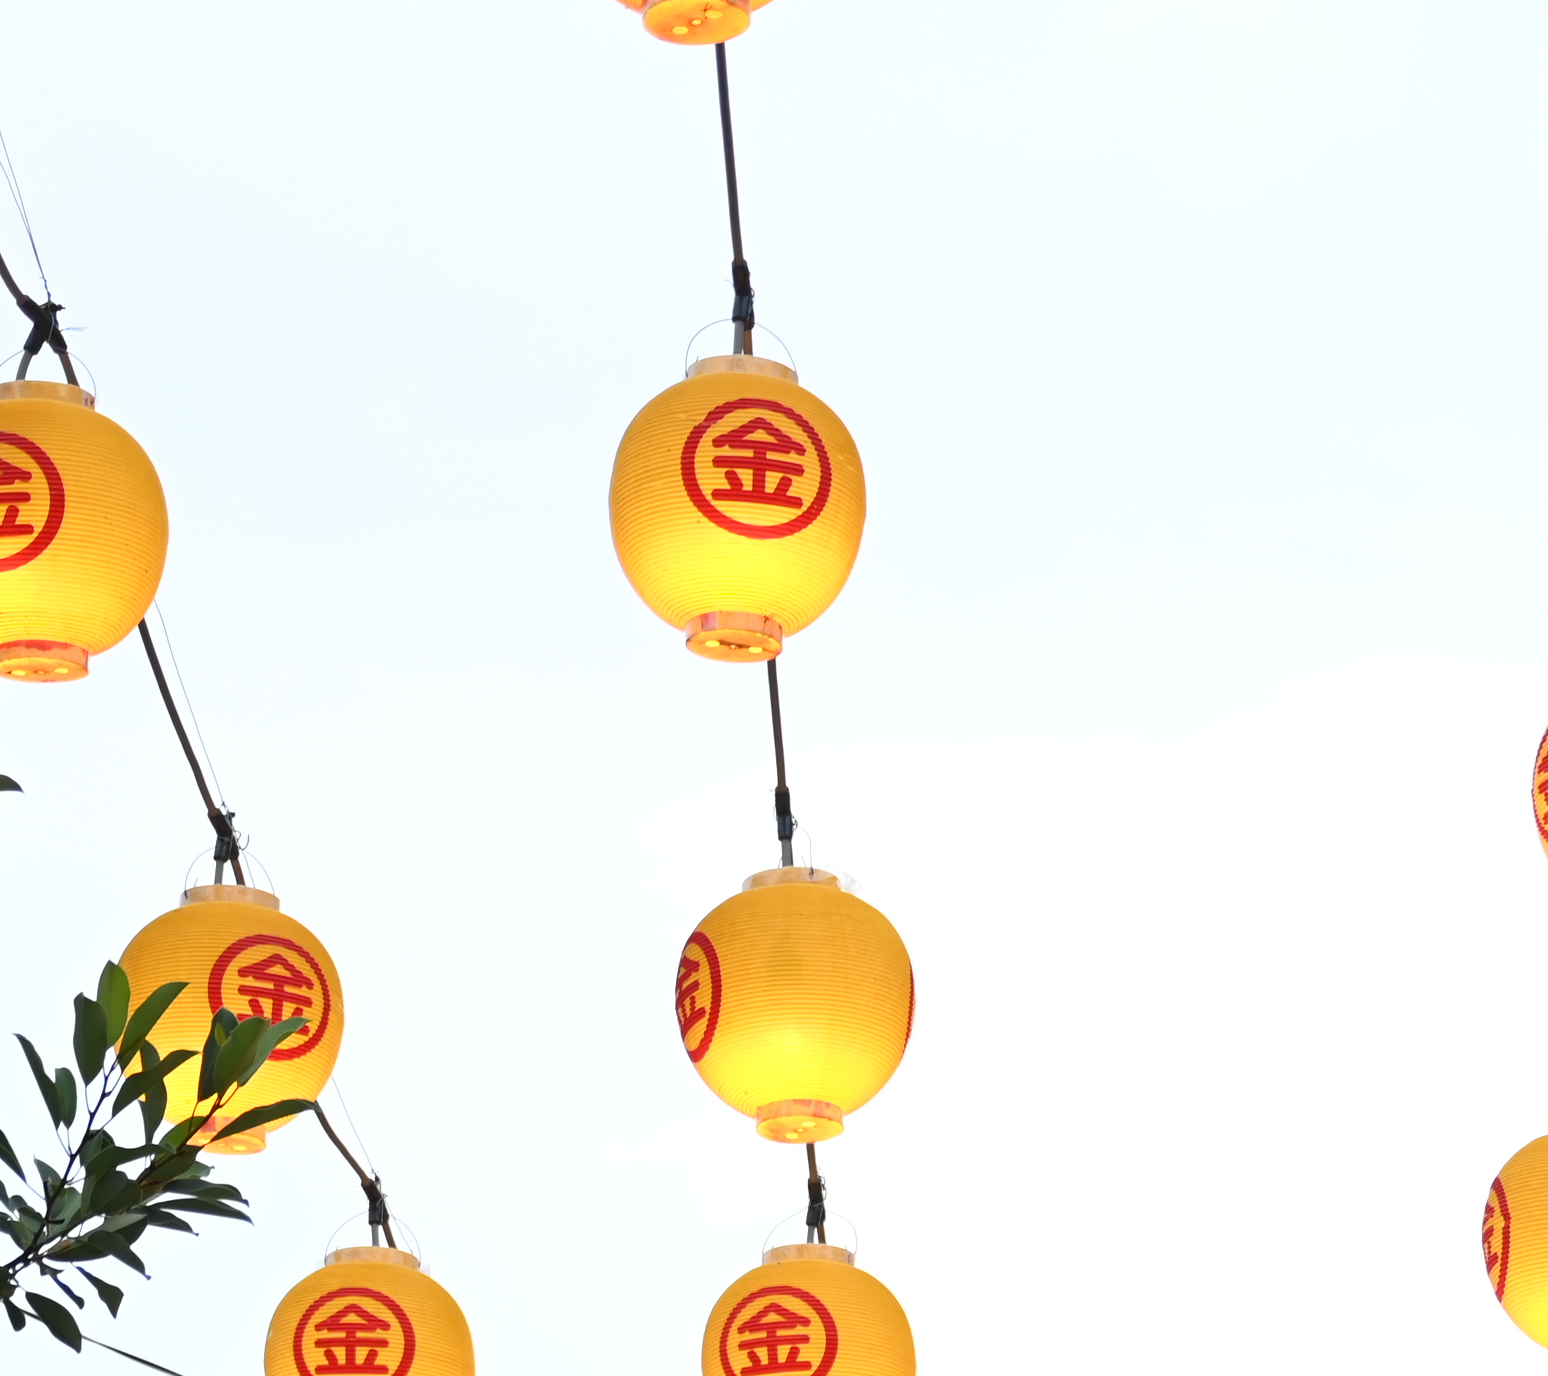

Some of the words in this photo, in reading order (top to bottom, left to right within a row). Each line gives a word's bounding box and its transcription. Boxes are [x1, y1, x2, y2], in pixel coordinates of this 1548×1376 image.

[711, 417, 808, 509] 金
[315, 1303, 392, 1375] 金
[738, 1302, 813, 1376] 金
